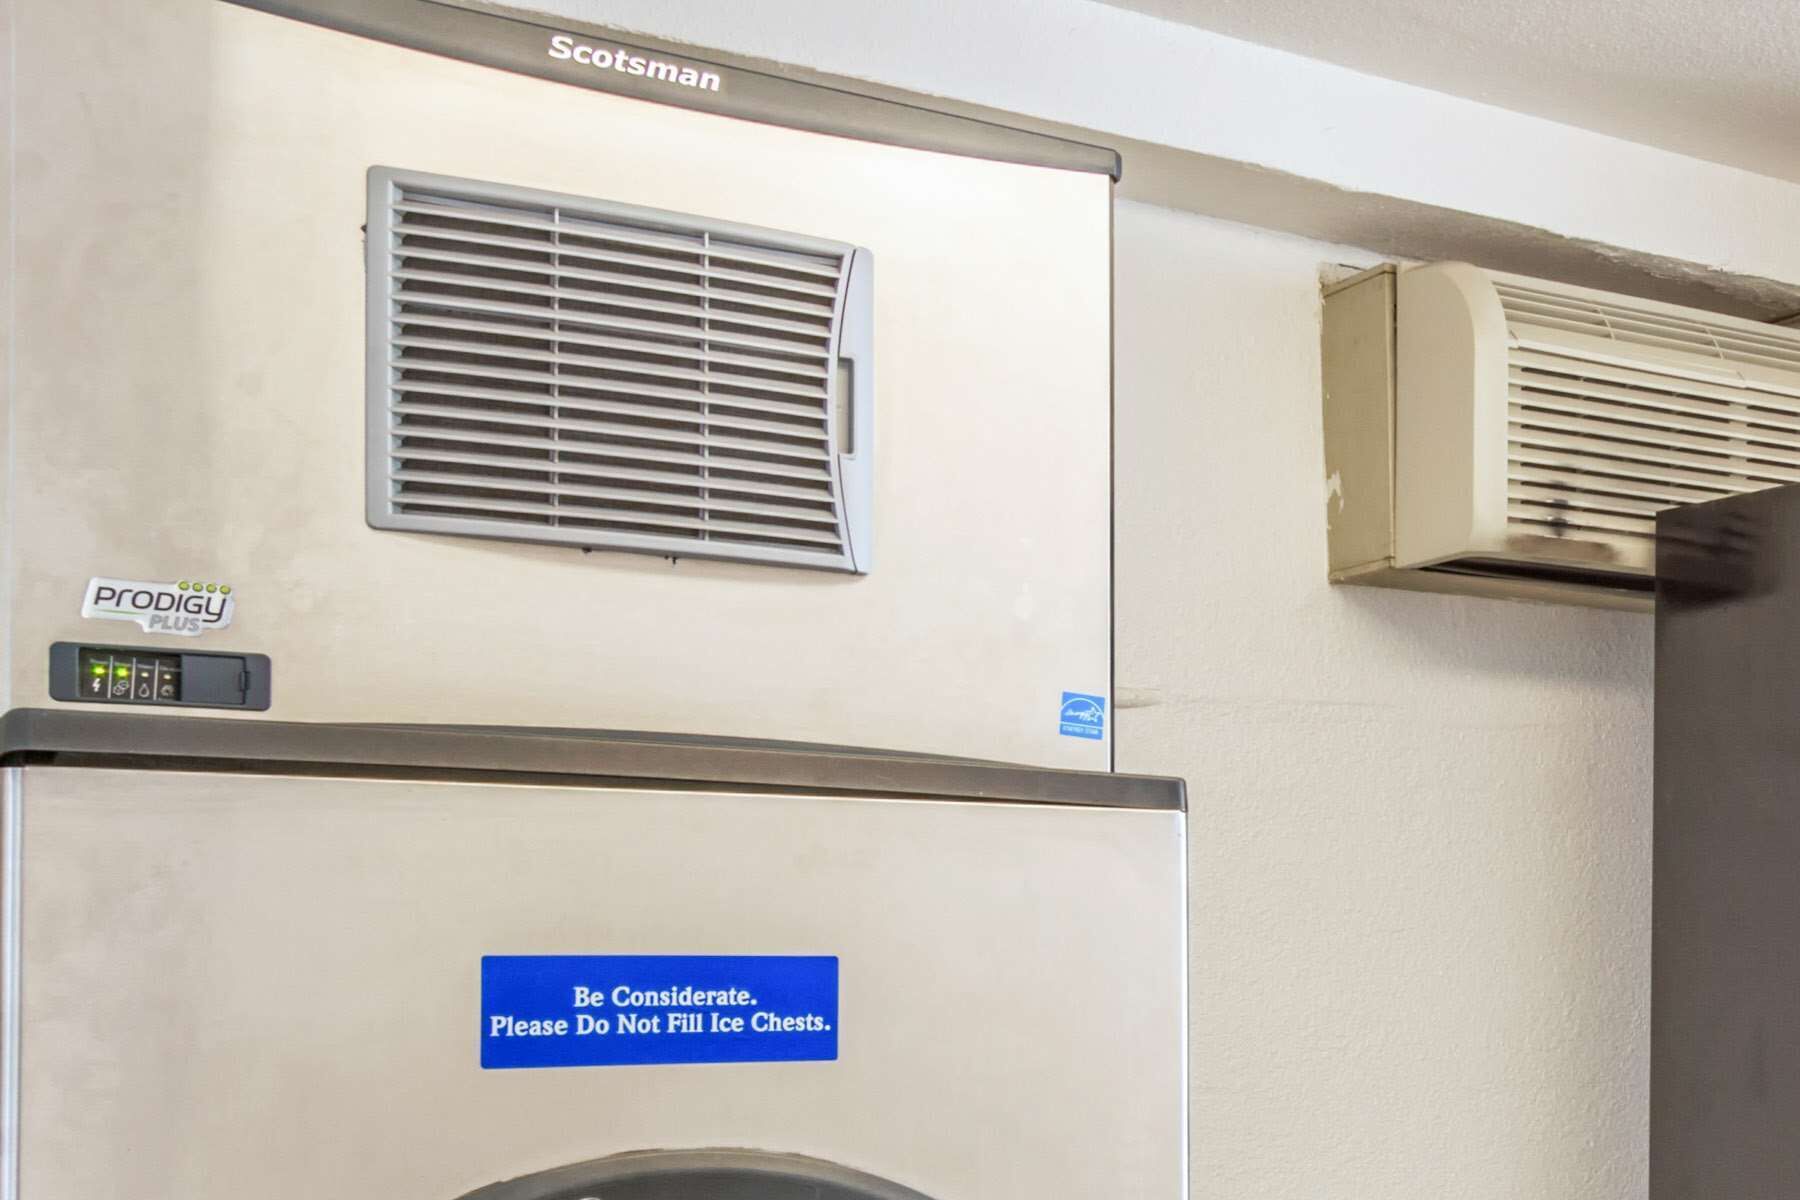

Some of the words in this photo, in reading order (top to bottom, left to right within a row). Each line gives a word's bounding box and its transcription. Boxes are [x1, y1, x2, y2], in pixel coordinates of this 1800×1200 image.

[547, 34, 721, 92] Scotsman
[148, 614, 201, 632] PLUS
[573, 986, 604, 1008] Be
[611, 985, 758, 1007] Considerate.
[489, 1015, 569, 1037] Please
[575, 1014, 610, 1036] Do
[616, 1013, 661, 1035] Not
[667, 1012, 704, 1034] Fill
[711, 1012, 744, 1033] Ice
[750, 1011, 832, 1033] Chests.
